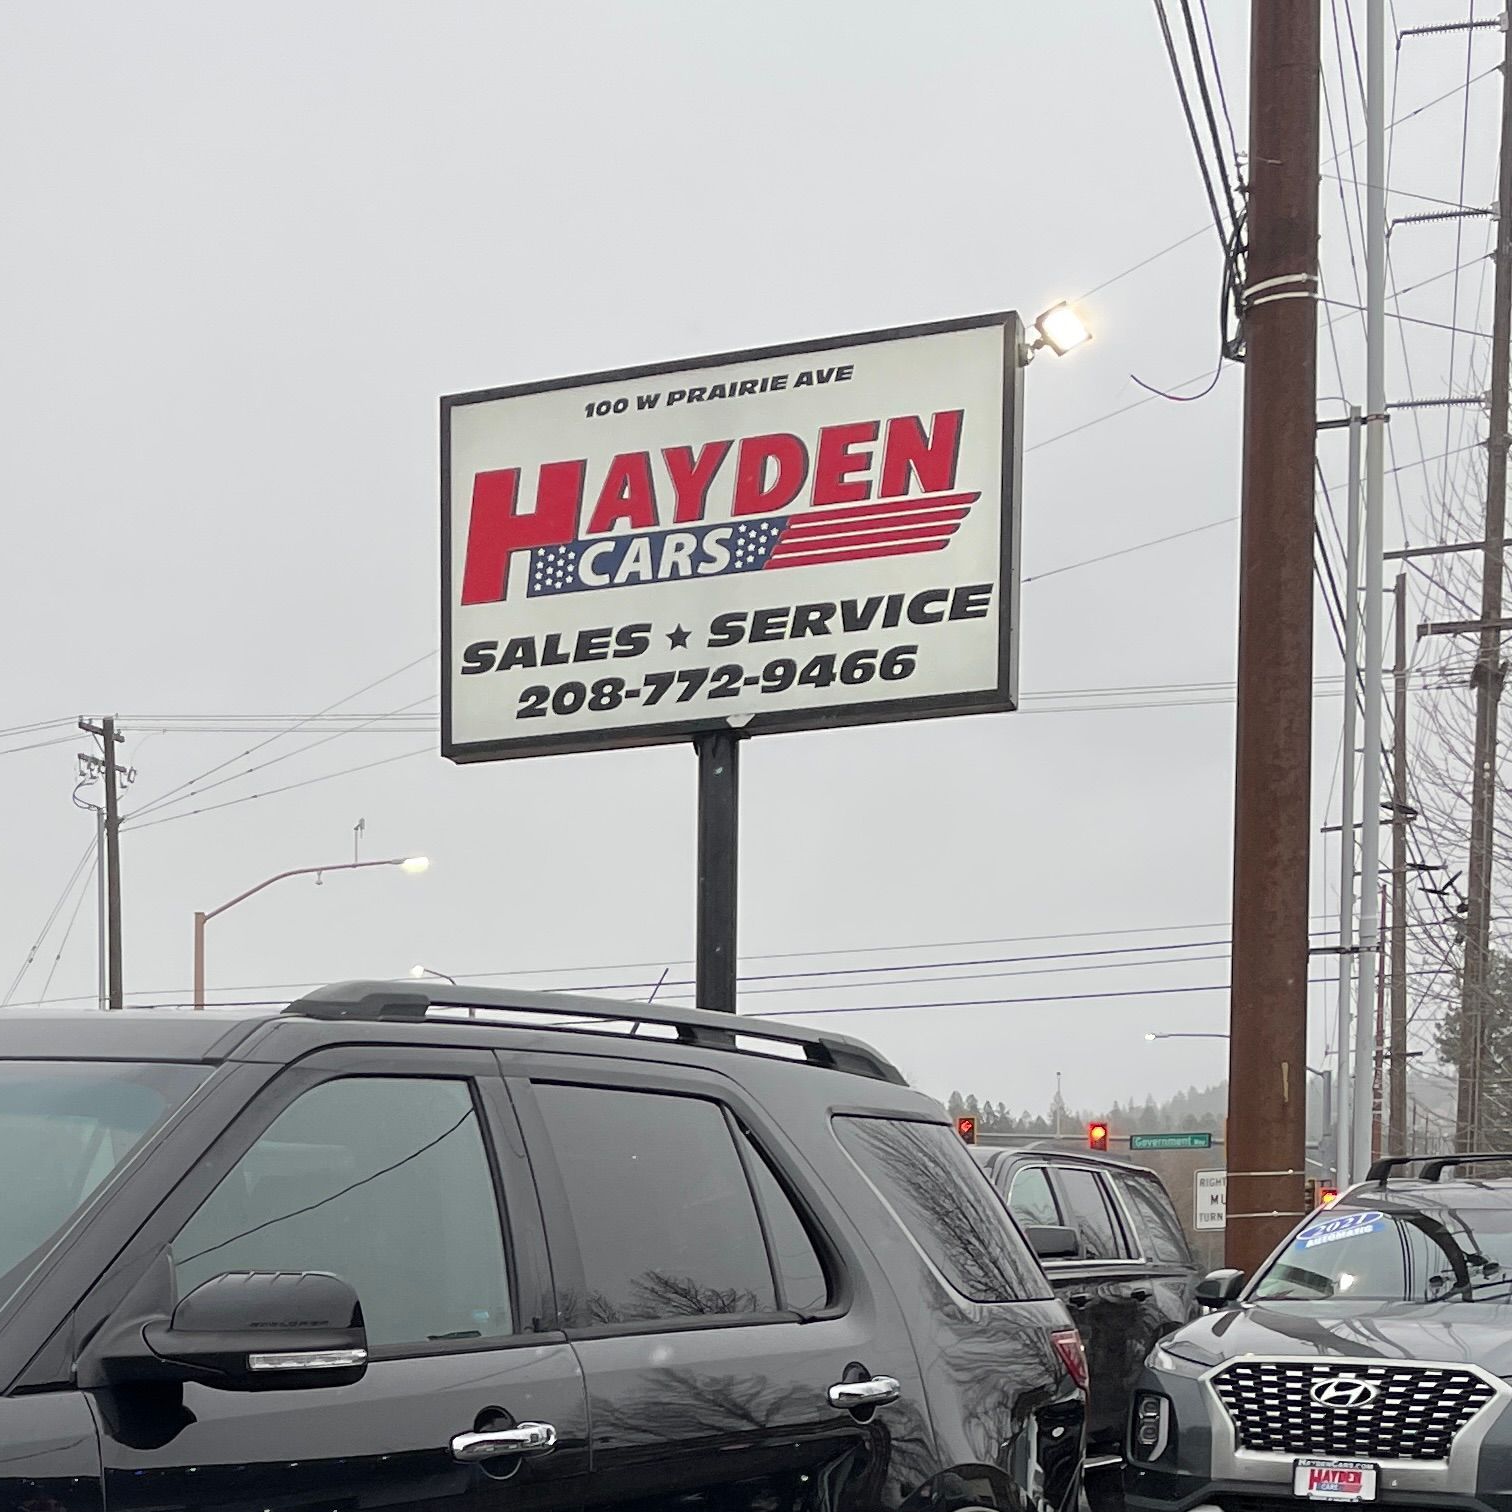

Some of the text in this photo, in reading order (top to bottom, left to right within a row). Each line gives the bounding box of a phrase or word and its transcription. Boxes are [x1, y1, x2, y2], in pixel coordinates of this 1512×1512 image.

[584, 364, 855, 419] 100 W PRAIRIE AVE
[460, 408, 966, 607] HAYDEN
[577, 526, 734, 590] CARS
[460, 582, 994, 675] SALES SERVICE
[515, 644, 919, 720] 208-772-9466
[1134, 1136, 1192, 1148] Government
[1199, 1178, 1226, 1188] RIGHT
[1199, 1213, 1224, 1222] TURN
[1305, 1224, 1374, 1249] AUTOMATIC
[1313, 1213, 1368, 1235] 2021
